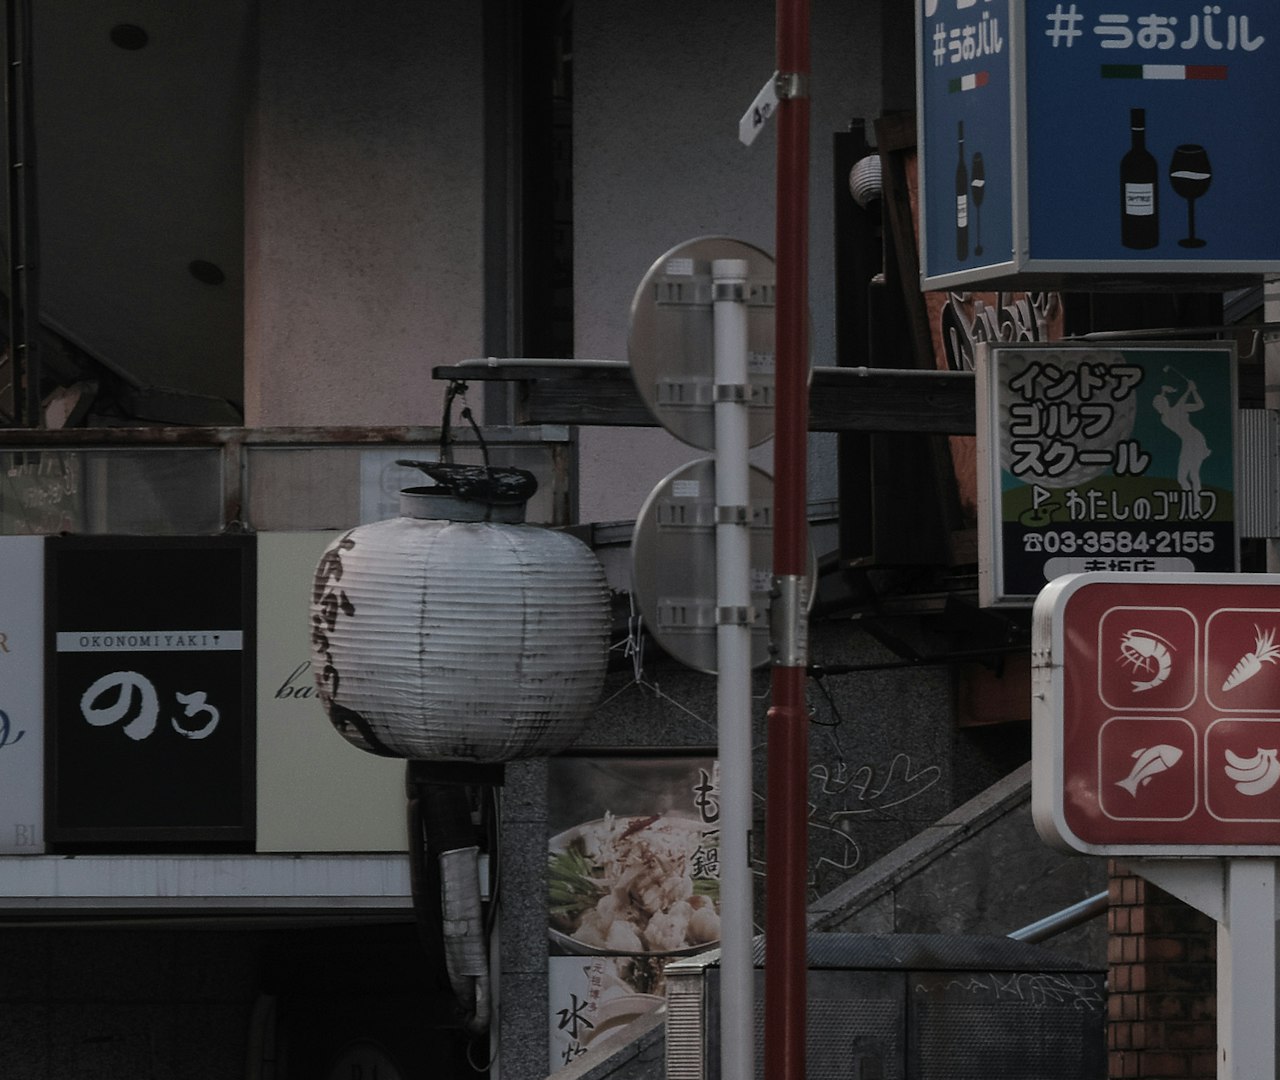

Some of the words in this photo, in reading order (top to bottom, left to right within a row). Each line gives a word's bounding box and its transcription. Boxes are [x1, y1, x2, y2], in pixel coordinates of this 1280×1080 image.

[932, 10, 1004, 67] #うおバル
[1045, 3, 1266, 52] #うおバル
[1008, 360, 1145, 402] インドア
[1009, 400, 1115, 439] ゴルフ
[1011, 439, 1152, 478] スクール
[1064, 487, 1218, 522] わたしのゴルフ
[79, 634, 208, 648] OKONOMIYAKI
